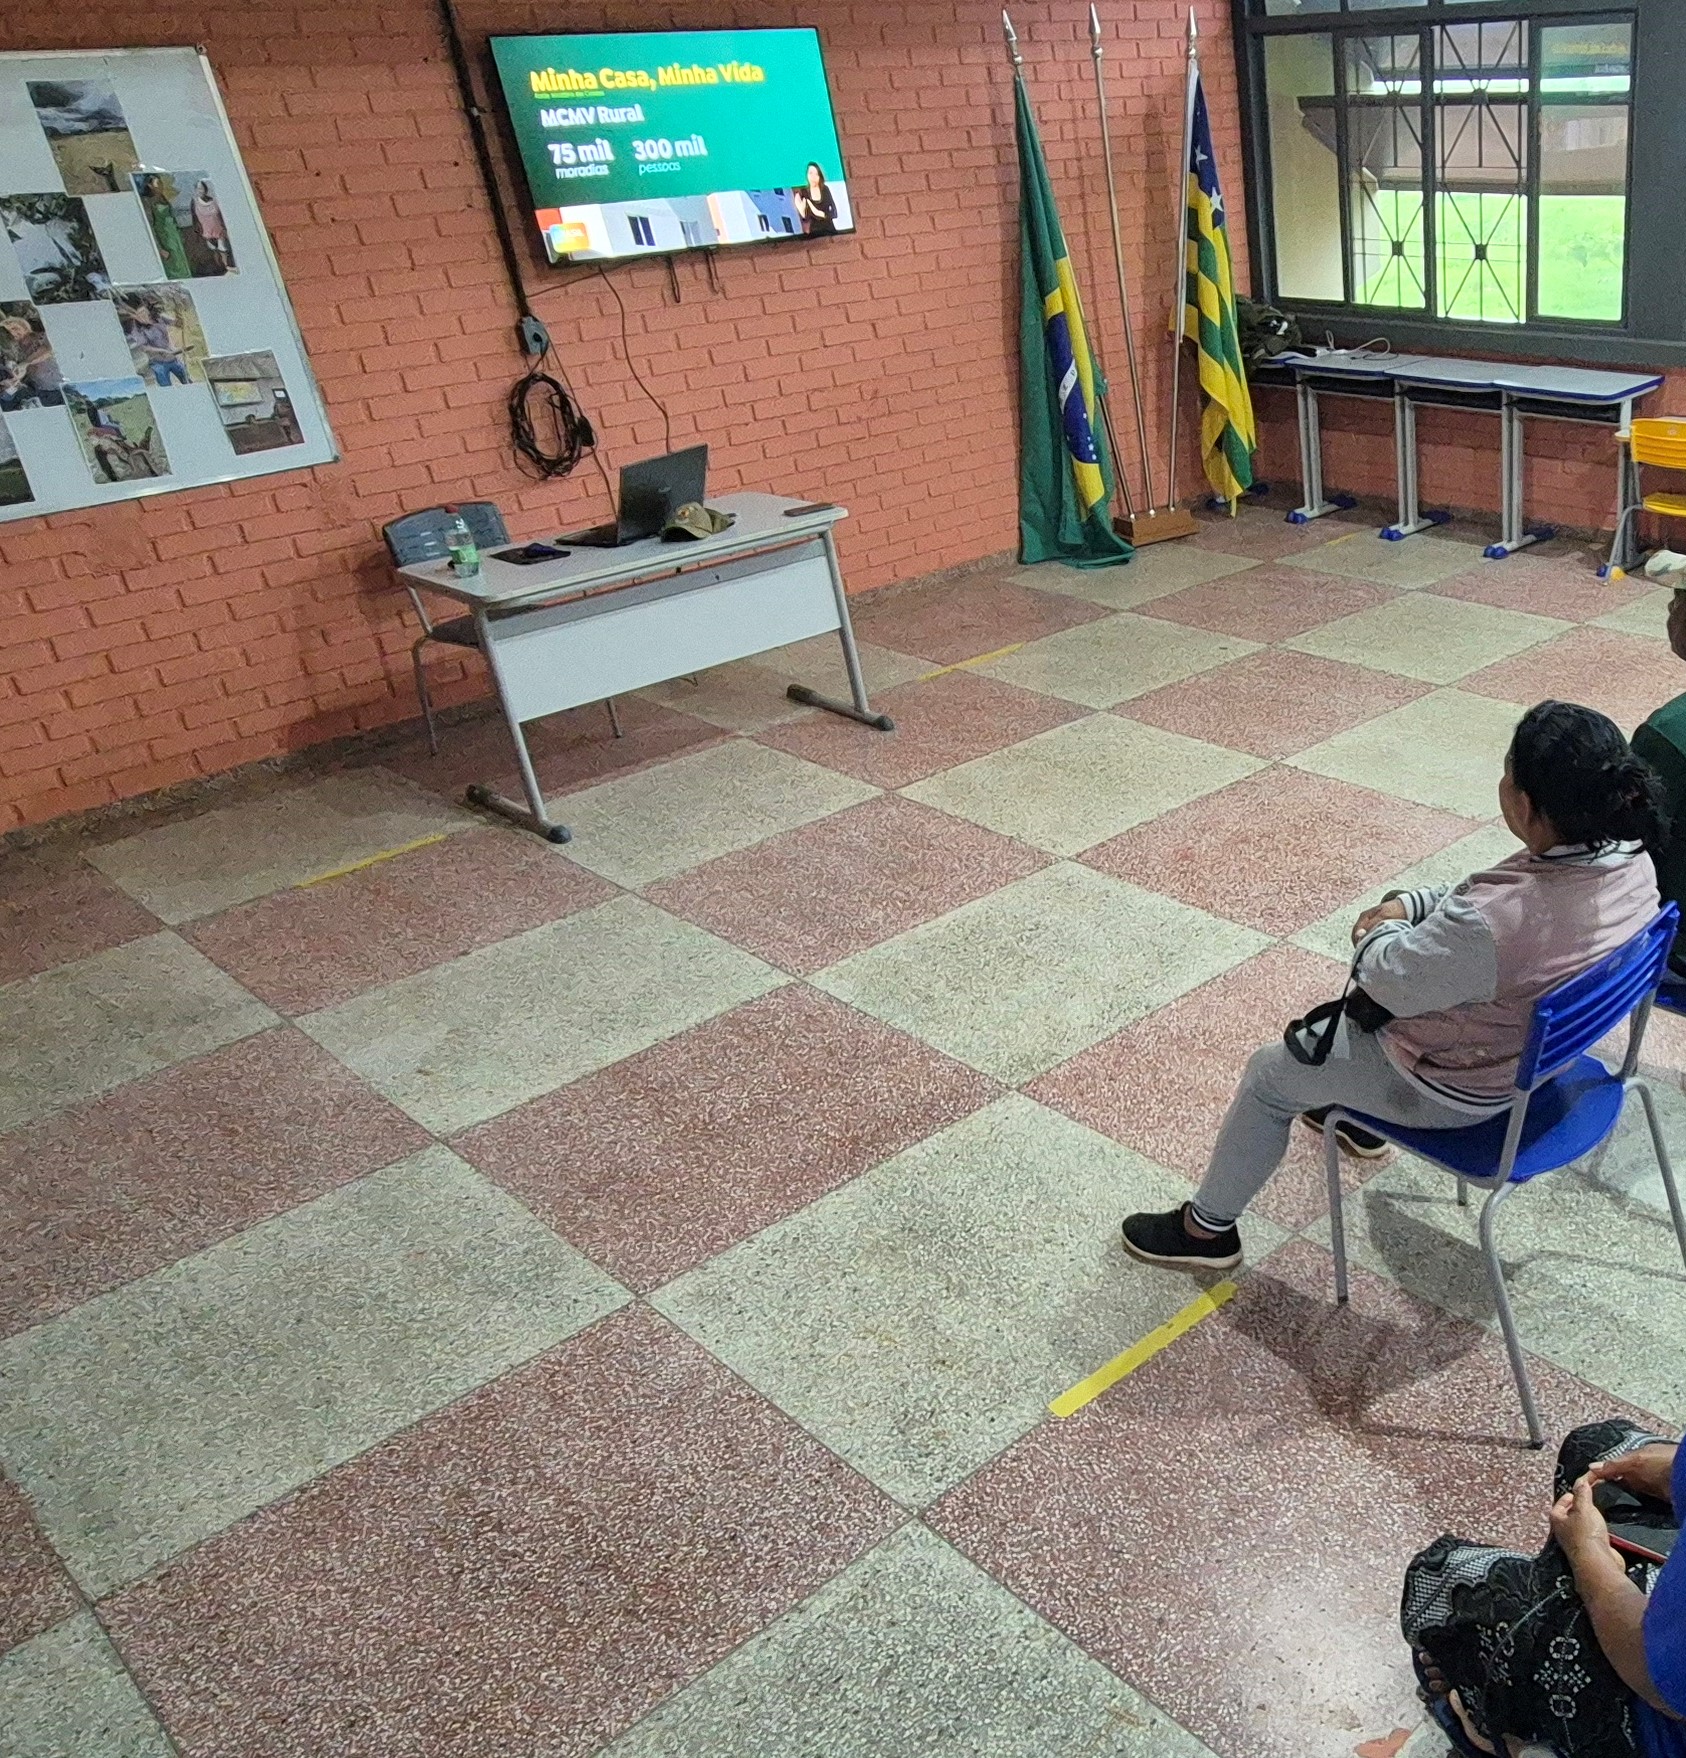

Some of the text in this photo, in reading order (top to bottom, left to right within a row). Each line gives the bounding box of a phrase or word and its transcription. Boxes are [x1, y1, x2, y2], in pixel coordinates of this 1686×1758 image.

[530, 60, 765, 92] Minha Casa, Minha Vida
[540, 103, 645, 128] MCMV Rural
[547, 133, 708, 165] 75 mil 300 mil
[555, 161, 681, 179] moradias pessoas
